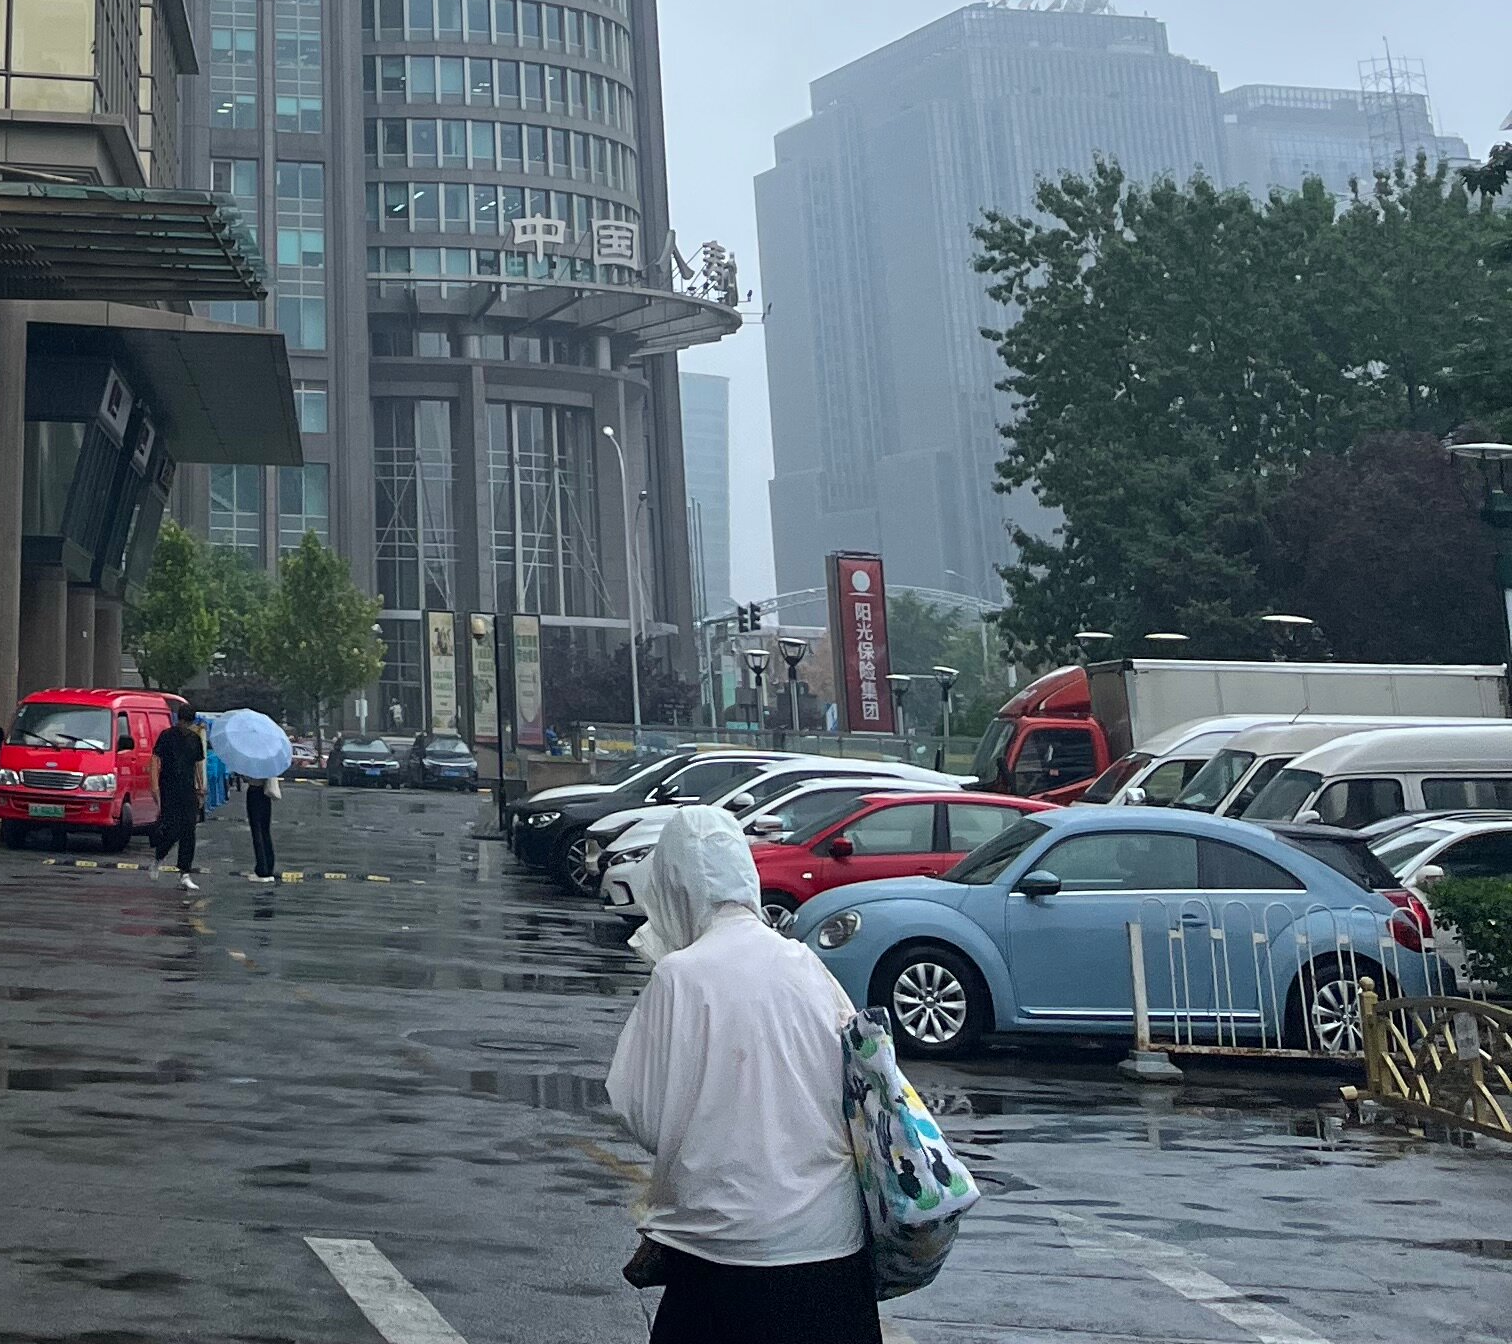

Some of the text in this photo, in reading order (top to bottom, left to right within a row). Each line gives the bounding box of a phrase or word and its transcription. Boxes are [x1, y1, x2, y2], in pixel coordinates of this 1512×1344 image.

[511, 212, 738, 308] 中国人寿
[854, 602, 880, 721] 阳光保险集团
